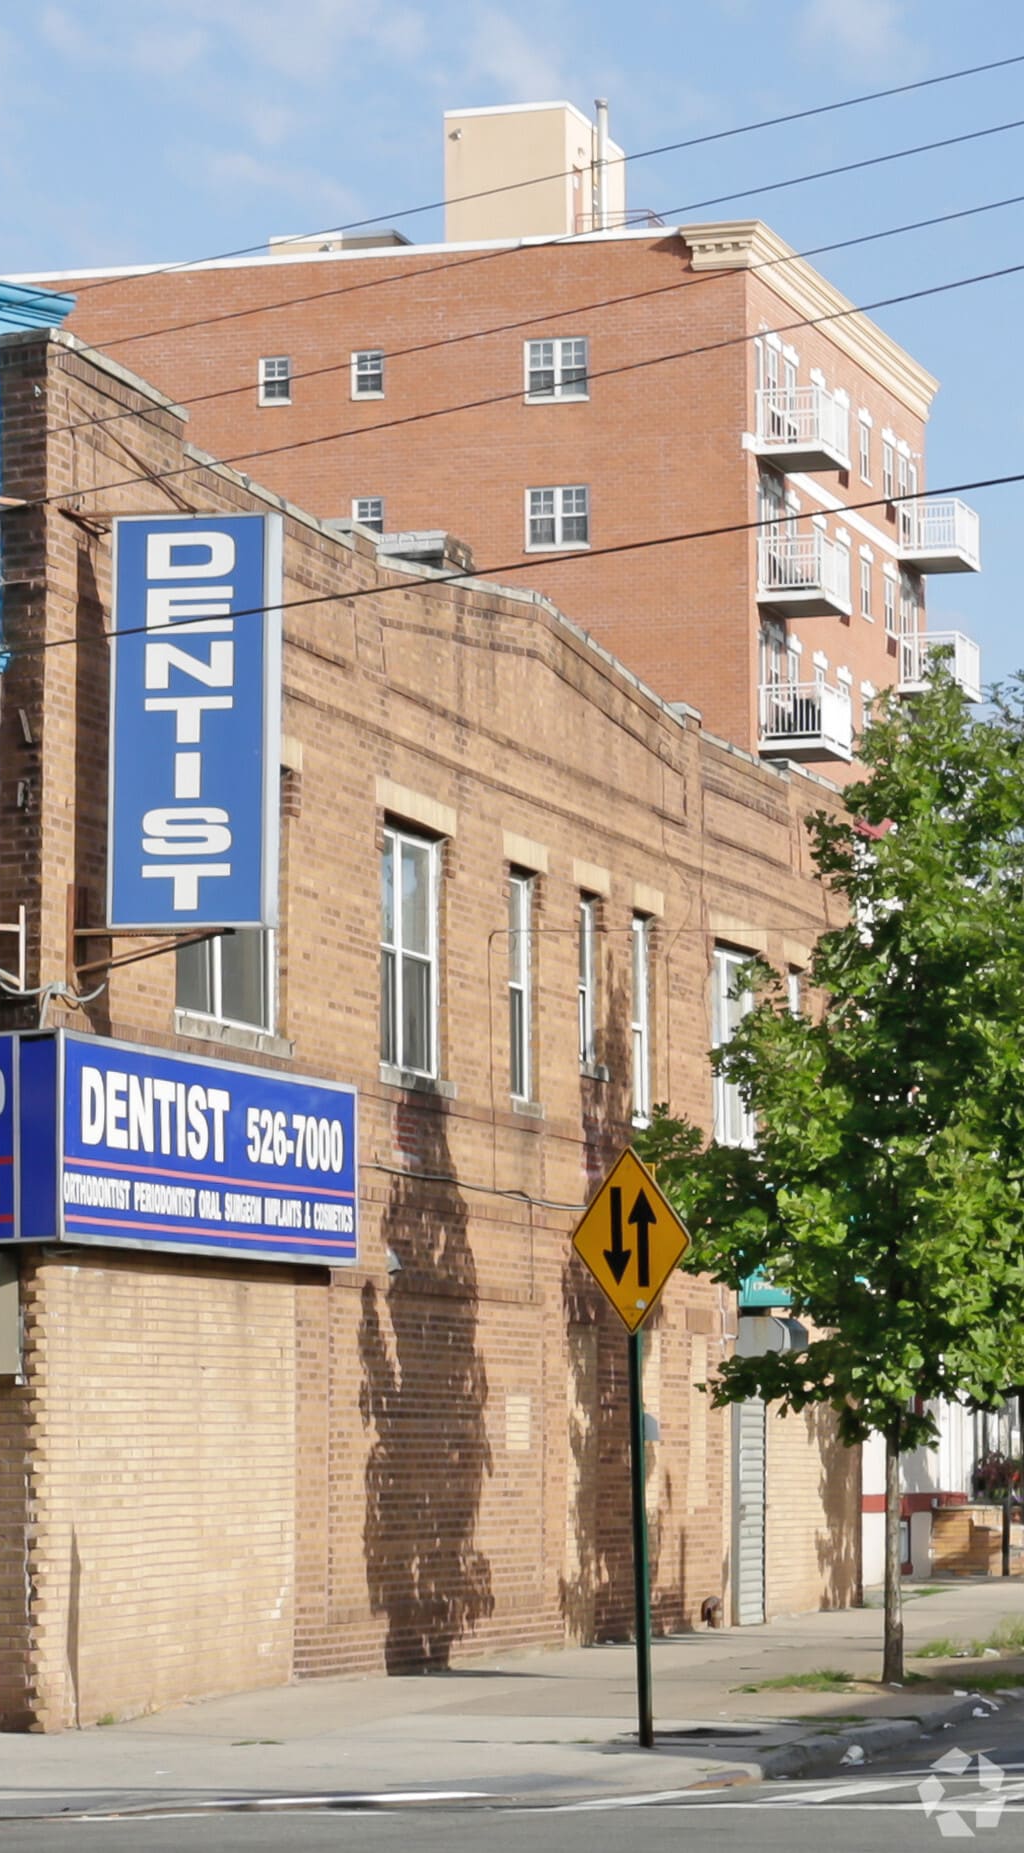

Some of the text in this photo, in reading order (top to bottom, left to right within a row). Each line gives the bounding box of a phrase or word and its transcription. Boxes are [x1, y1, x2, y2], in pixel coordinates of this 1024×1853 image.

[141, 531, 236, 911] DENTIST
[81, 1066, 343, 1173] DENTIST 526-7000
[64, 1171, 131, 1210] ORTHODONTIST
[134, 1181, 195, 1218] PERIODONTIST
[198, 1189, 222, 1220] ORAL
[225, 1192, 261, 1225] SURGEON
[264, 1196, 302, 1229] IMPLANTS
[313, 1202, 353, 1232] COSMETICS
